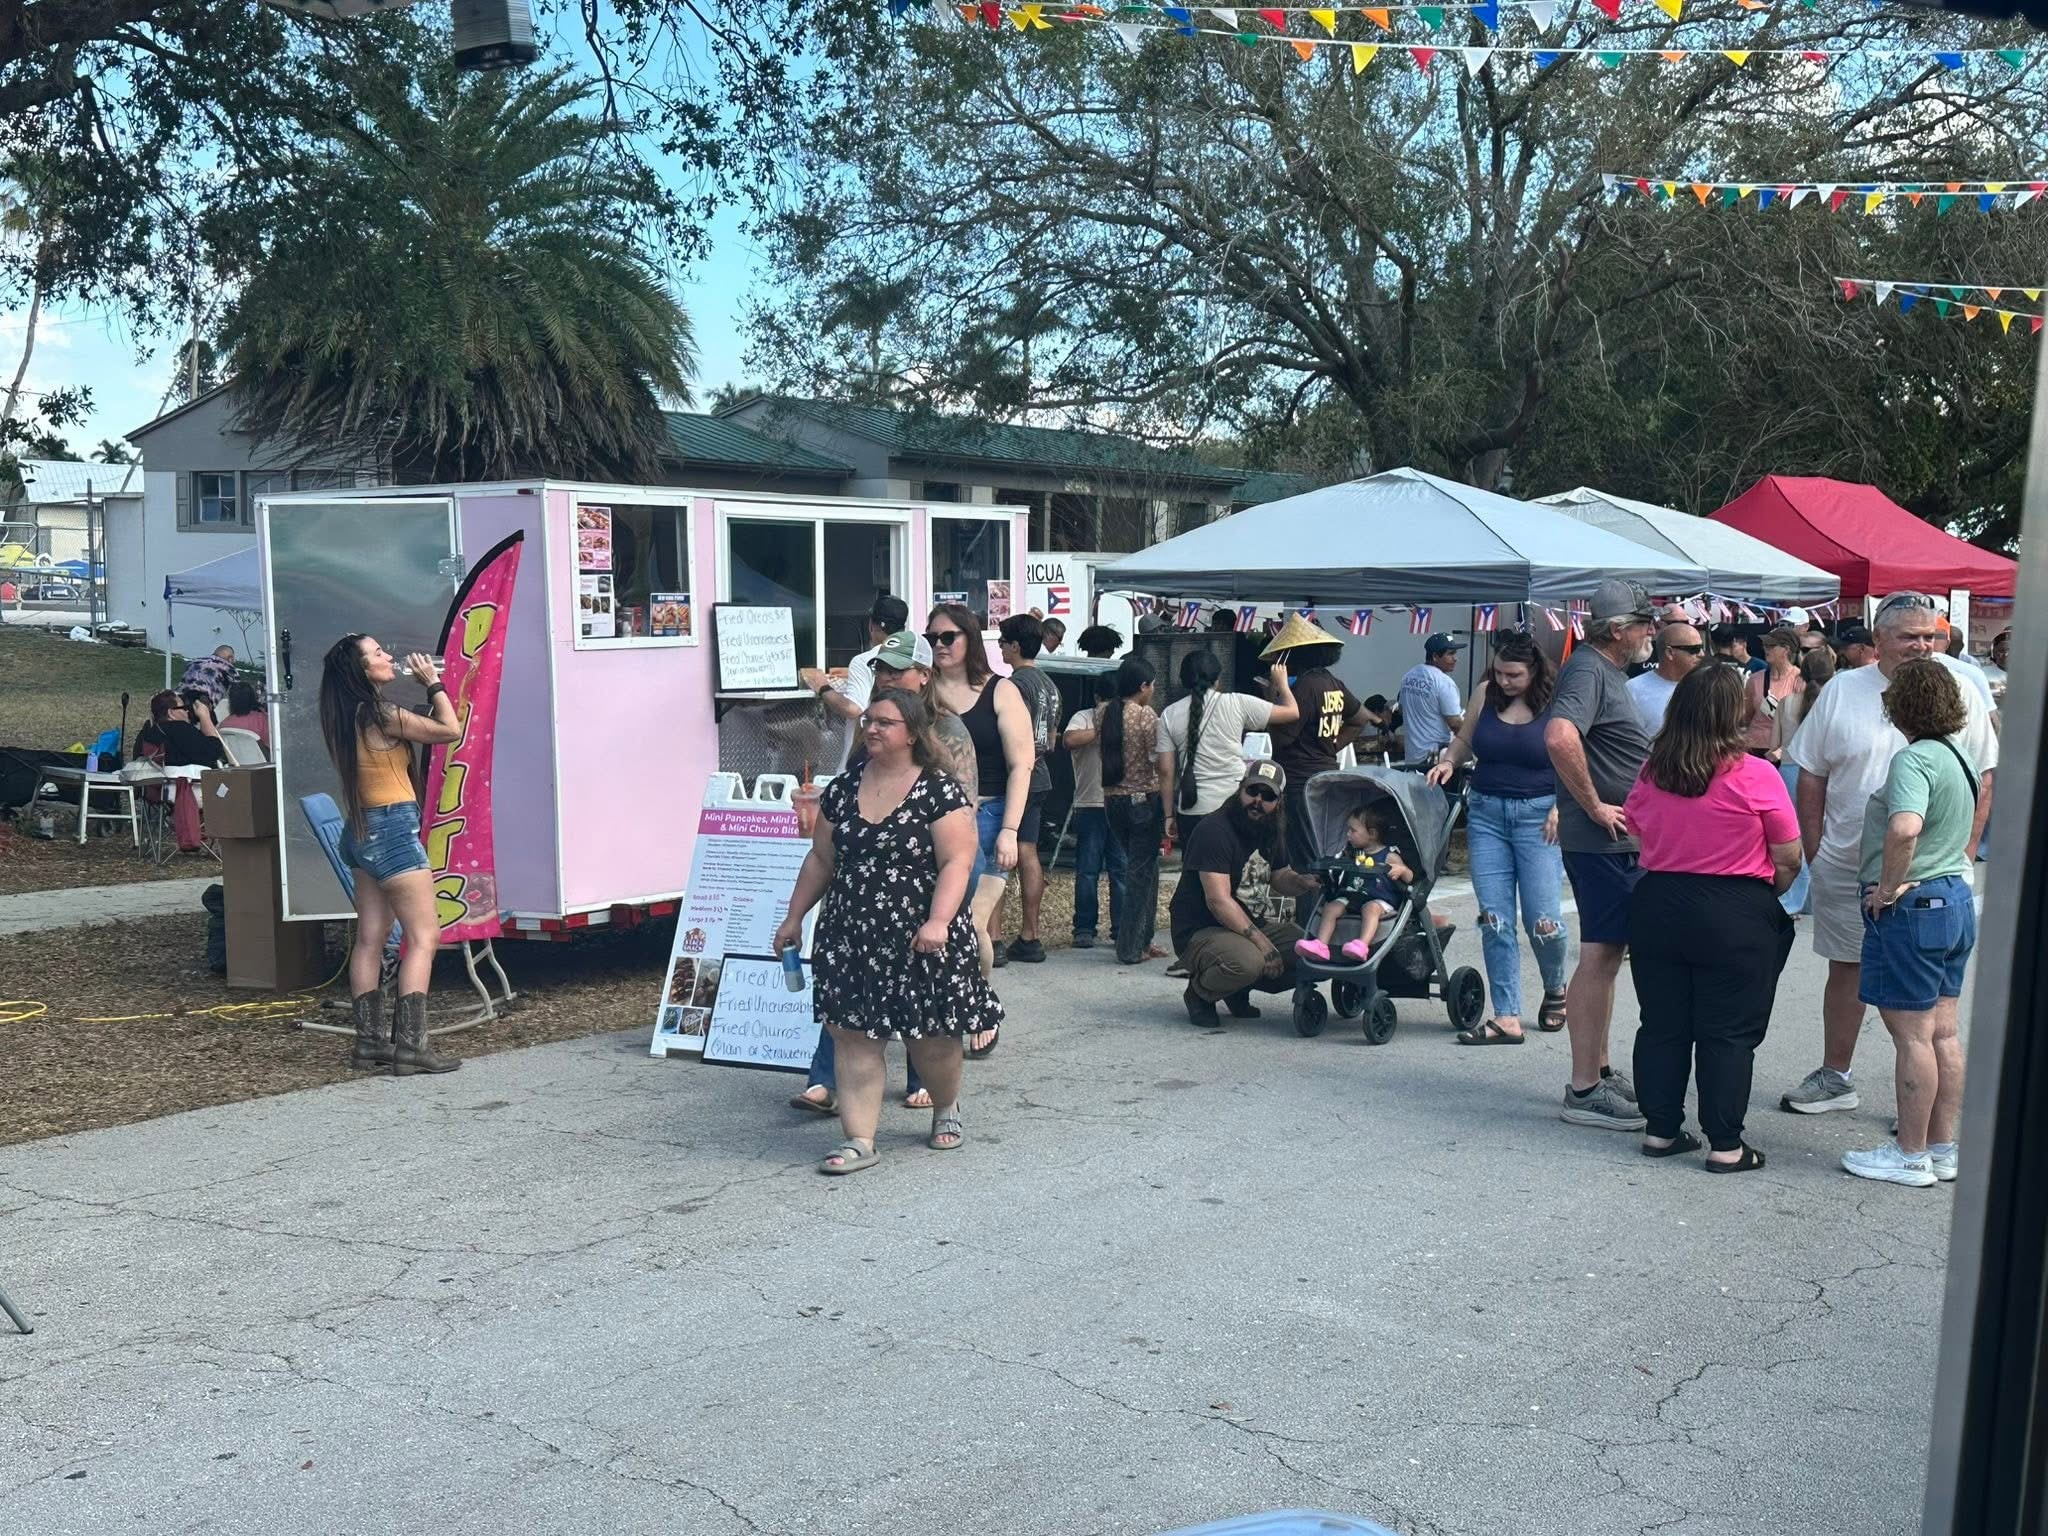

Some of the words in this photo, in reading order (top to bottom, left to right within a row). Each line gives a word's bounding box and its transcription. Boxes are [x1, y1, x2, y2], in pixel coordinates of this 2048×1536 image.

[704, 813, 723, 822] Mini
[725, 814, 768, 824] Pancakes,
[770, 815, 790, 824] Mini
[720, 824, 726, 832] &
[729, 824, 747, 832] Mini
[749, 824, 780, 834] Churro
[724, 962, 768, 986] Fried
[718, 990, 750, 1012] Fried
[712, 1017, 748, 1036] Fried
[752, 1020, 801, 1039] Churros
[748, 1046, 758, 1055] or
[1904, 1162, 1926, 1172] HOKA
